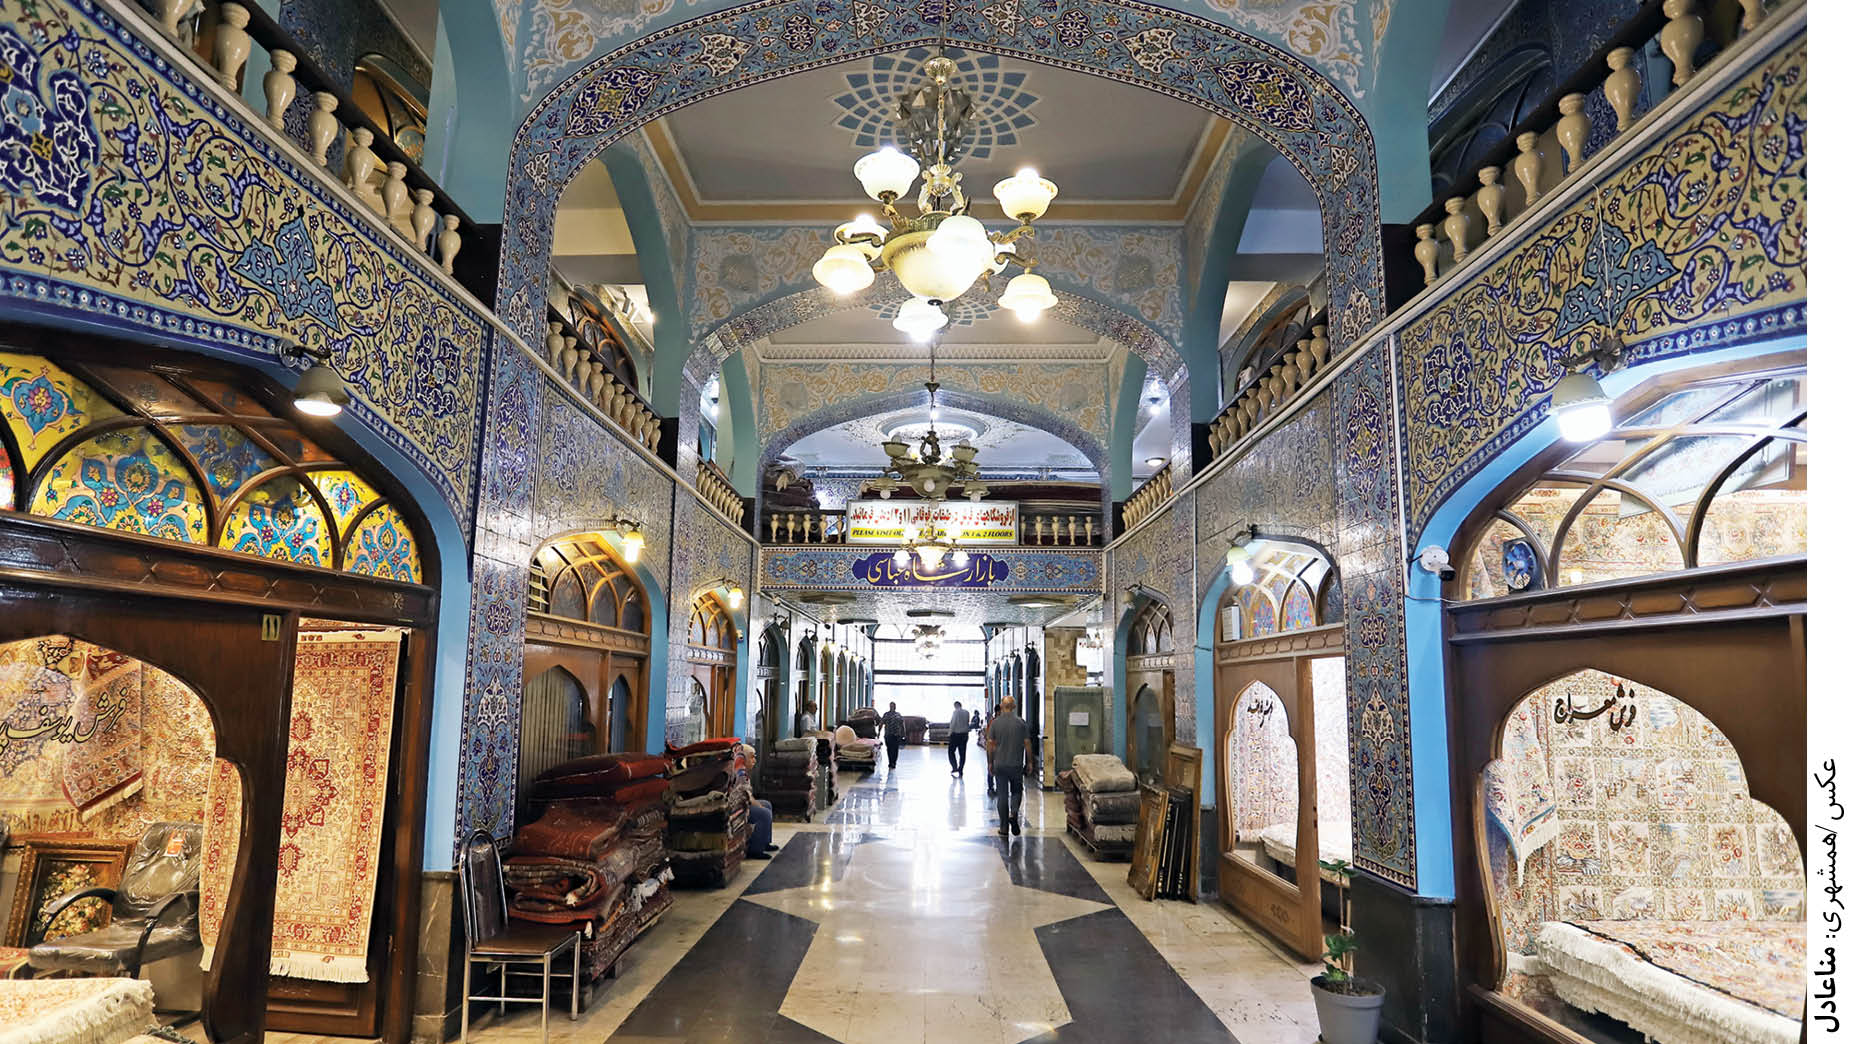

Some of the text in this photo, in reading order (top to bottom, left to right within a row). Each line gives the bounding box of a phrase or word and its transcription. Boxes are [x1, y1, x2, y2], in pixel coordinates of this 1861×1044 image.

[852, 528, 874, 536] PLEASE
[963, 554, 995, 587] بازار
[74, 687, 127, 743] فرش
[1553, 682, 1637, 731] فرش معراج
